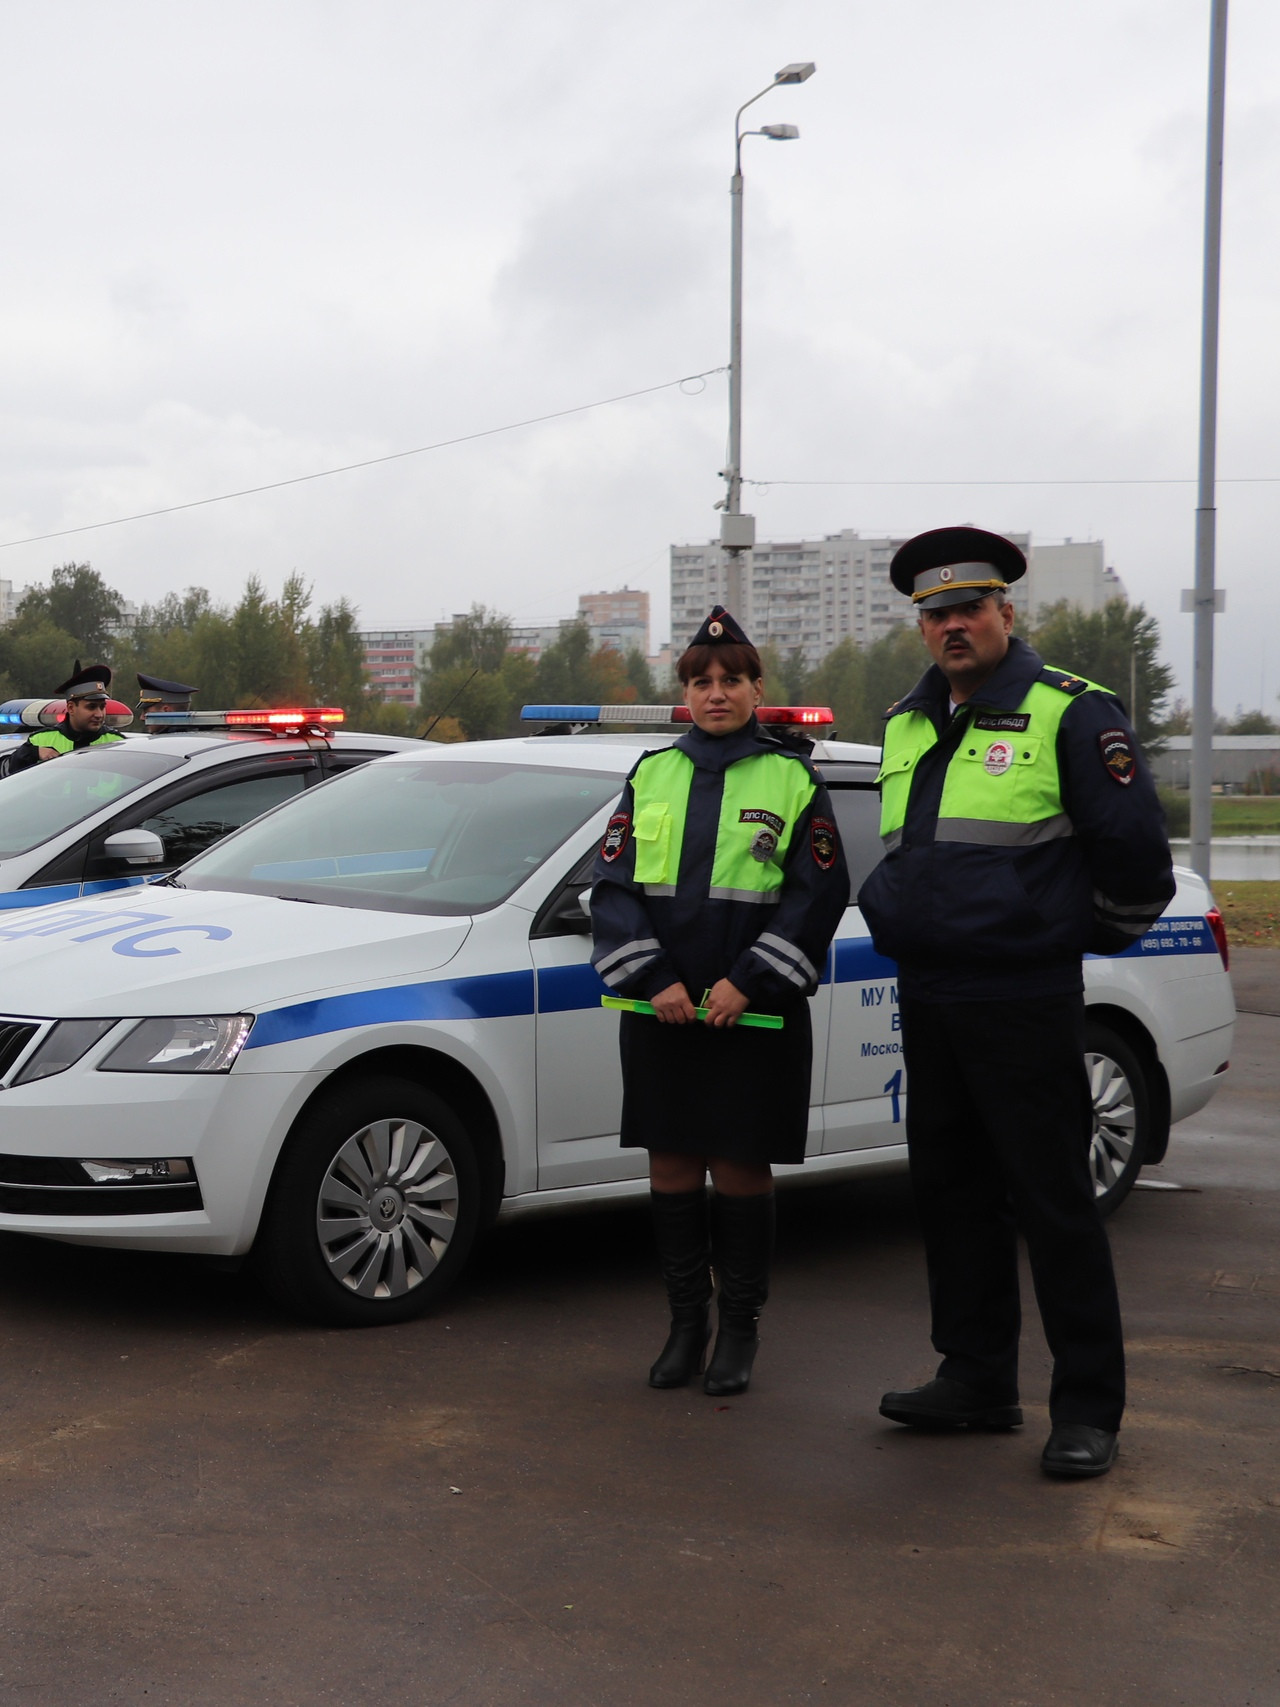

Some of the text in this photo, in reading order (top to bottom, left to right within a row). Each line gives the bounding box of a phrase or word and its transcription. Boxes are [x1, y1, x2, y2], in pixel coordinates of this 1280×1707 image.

[998, 718, 1025, 728] ГИБДД
[742, 811, 761, 820] ДПС
[861, 985, 899, 1007] МУ М
